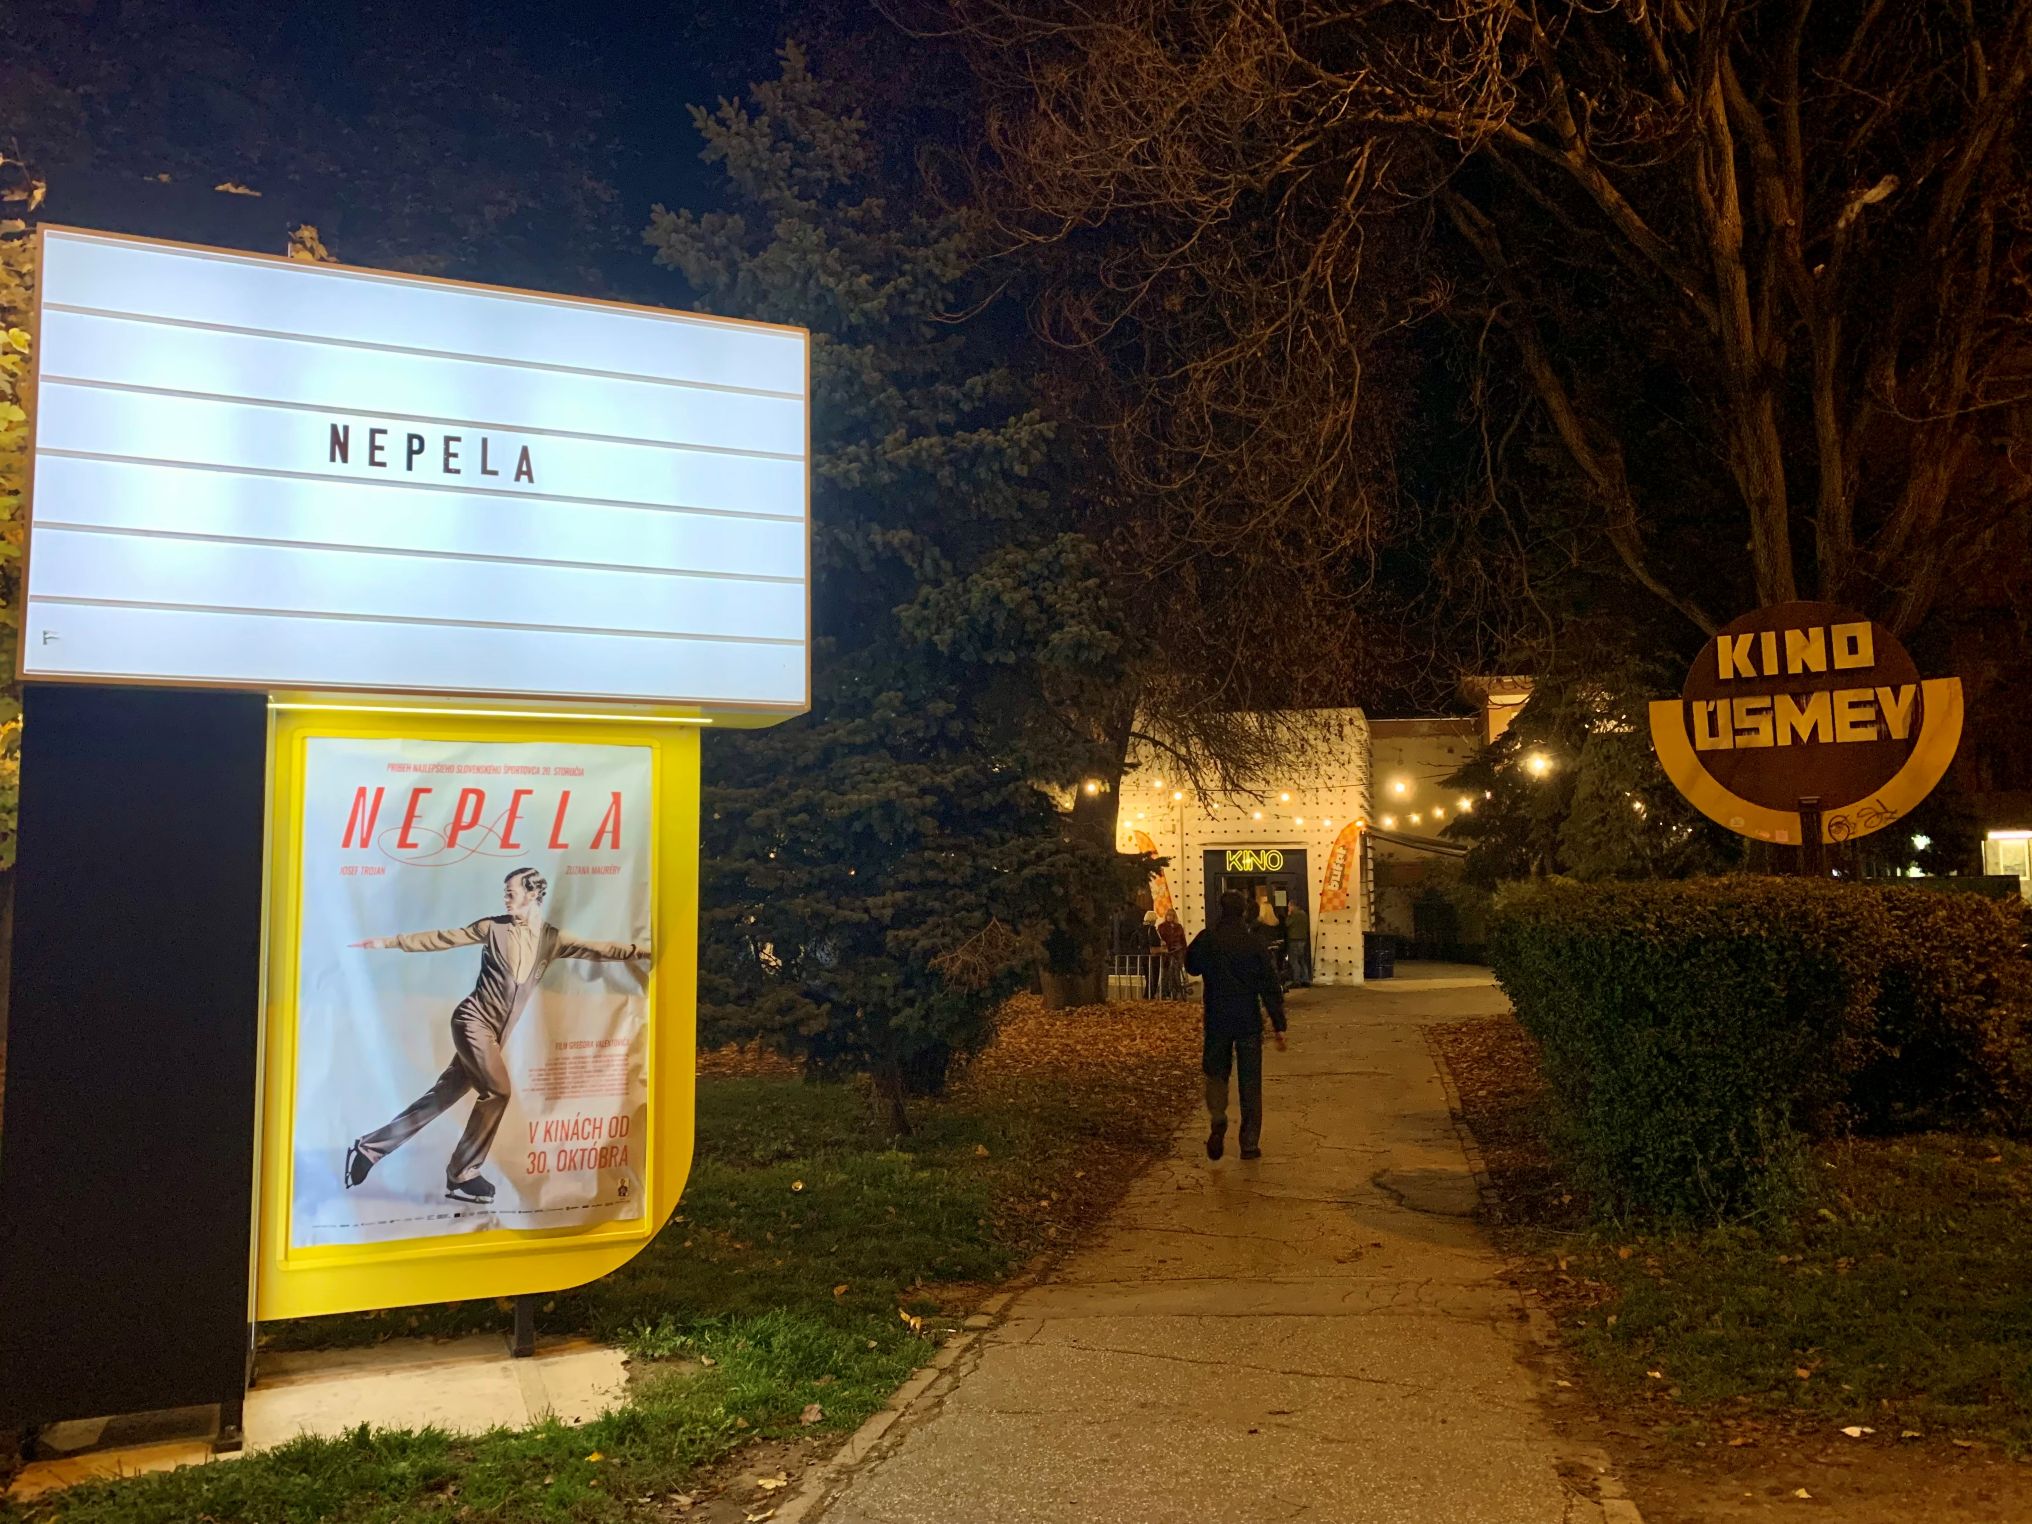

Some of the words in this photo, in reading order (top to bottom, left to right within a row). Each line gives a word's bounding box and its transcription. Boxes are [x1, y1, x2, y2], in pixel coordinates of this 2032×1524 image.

[329, 423, 534, 484] NEPELA
[1716, 621, 1875, 680] KINO
[1692, 684, 1917, 751] ÚSMEV
[341, 786, 622, 850] NEPELA
[1226, 849, 1284, 871] KINO
[527, 1151, 550, 1174] 30.
[556, 1141, 628, 1172] OKTÓBRA
[529, 1121, 538, 1144] V
[543, 1112, 603, 1143] KINÁCH
[608, 1115, 630, 1138] OD
